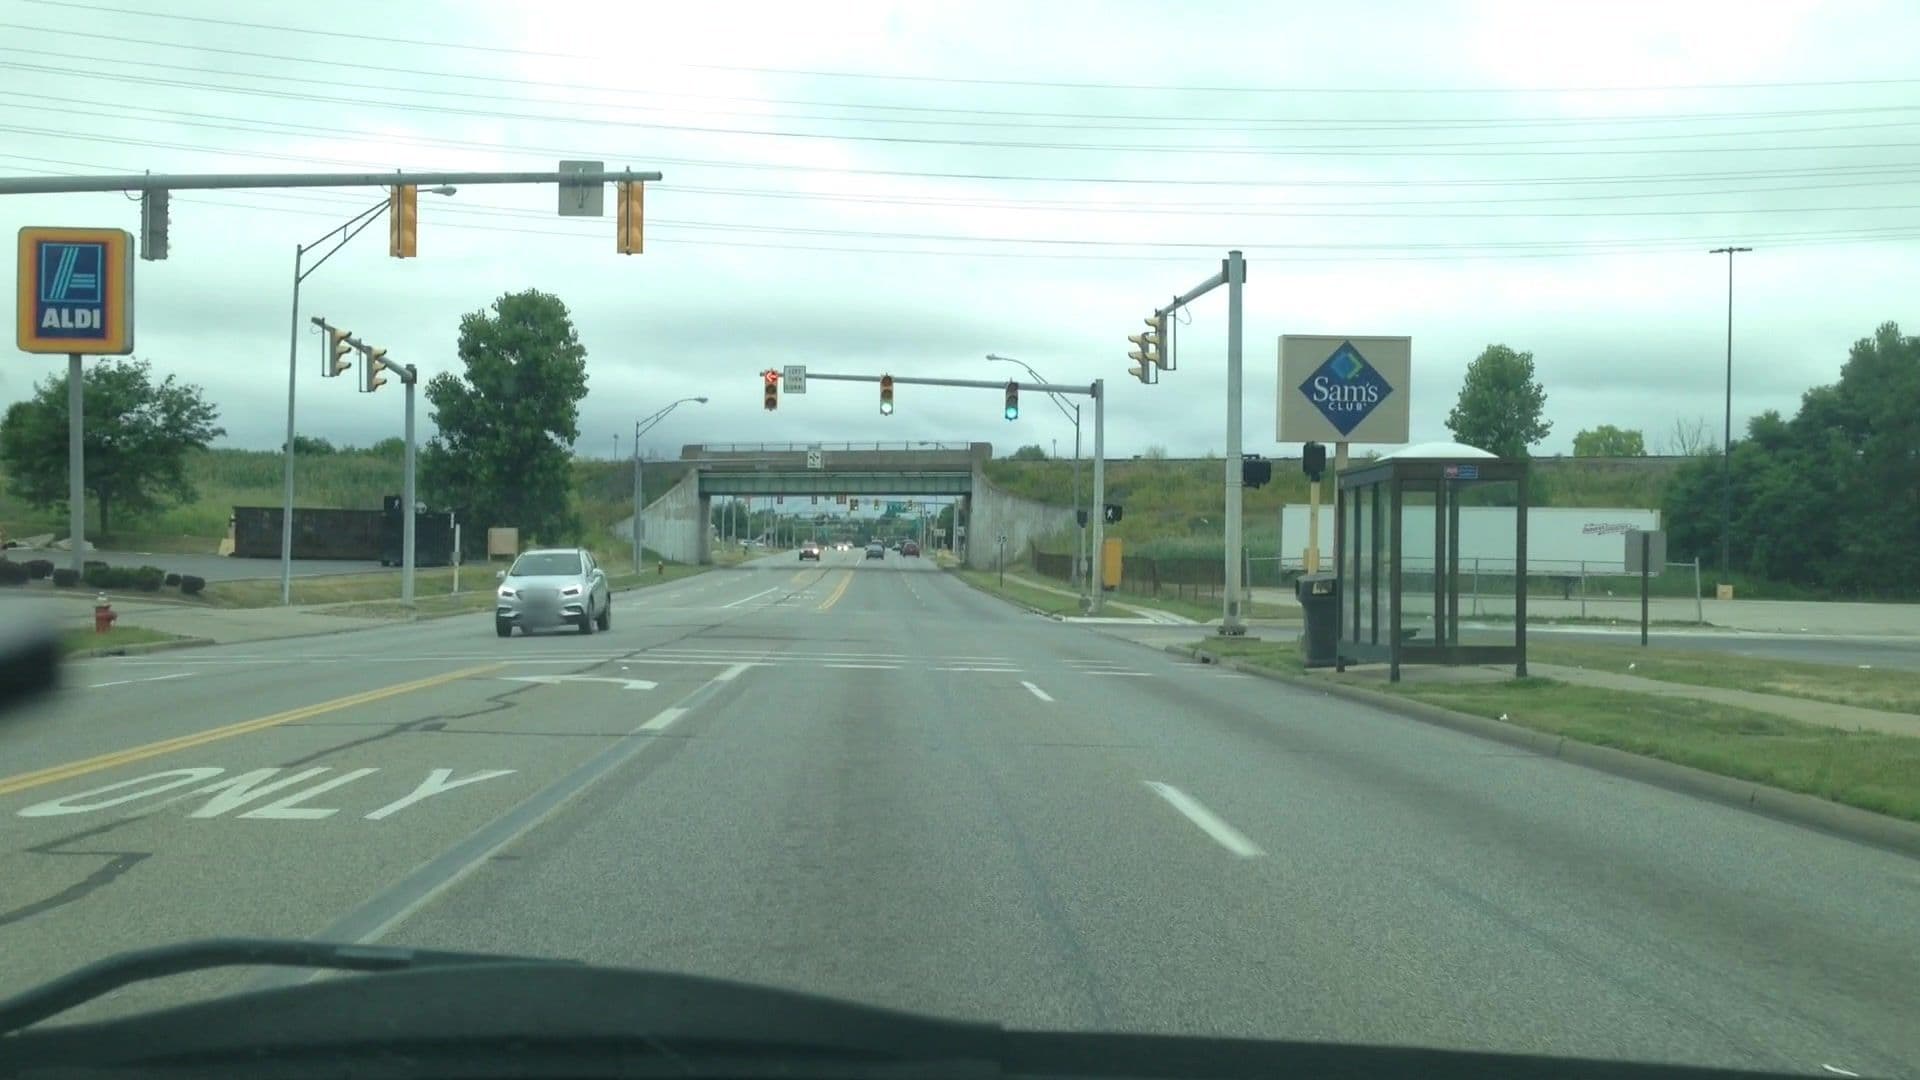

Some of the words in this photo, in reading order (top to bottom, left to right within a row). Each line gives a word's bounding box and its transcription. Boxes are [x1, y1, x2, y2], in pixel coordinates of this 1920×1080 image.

[41, 307, 101, 329] ALDI
[1313, 376, 1379, 403] Sam's
[1328, 402, 1363, 411] CLUB
[15, 767, 519, 820] ONLY
